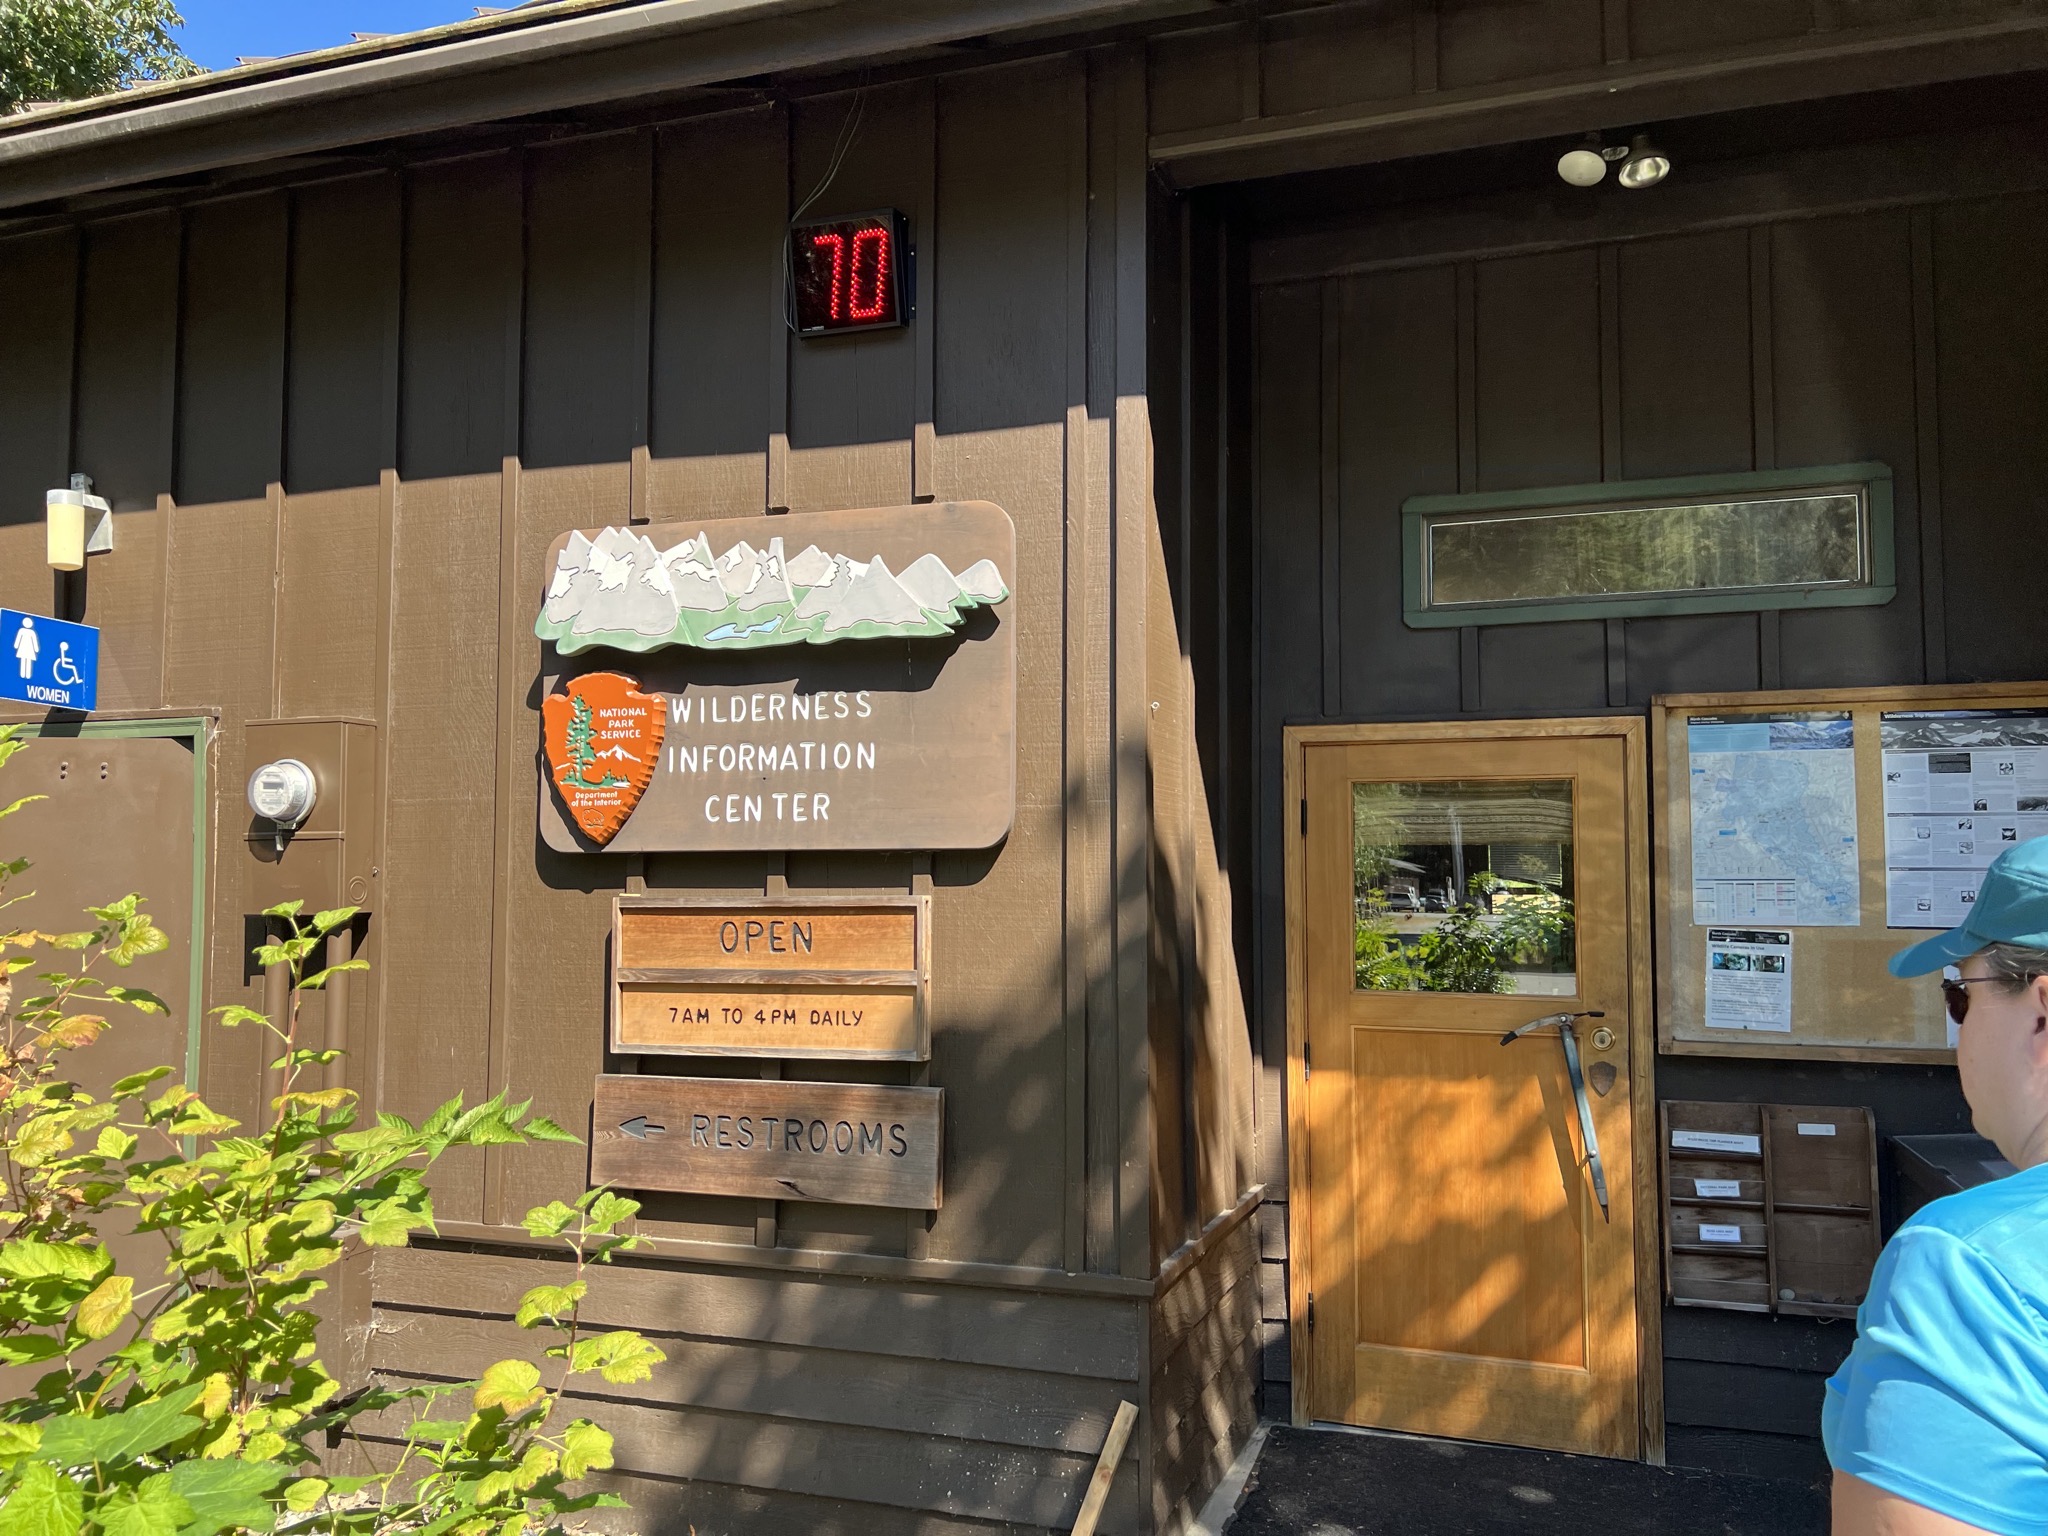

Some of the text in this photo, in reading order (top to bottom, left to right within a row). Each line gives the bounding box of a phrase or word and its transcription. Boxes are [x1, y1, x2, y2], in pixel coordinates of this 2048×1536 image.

[814, 227, 888, 319] 70
[26, 685, 70, 704] WOMEN
[599, 707, 648, 718] NATIONAL
[672, 690, 872, 724] WILDERNESS
[608, 718, 635, 728] PARK
[600, 729, 642, 740] SERVICE
[668, 741, 876, 773] INFORMATION
[575, 790, 618, 800] Department
[580, 799, 593, 807] the
[594, 799, 622, 807] Interior
[704, 792, 831, 823] CENTER
[719, 921, 813, 954] OPEN
[721, 1008, 743, 1025] TO
[810, 1010, 863, 1027] DAILY
[690, 1114, 908, 1158] RESTROOMS
